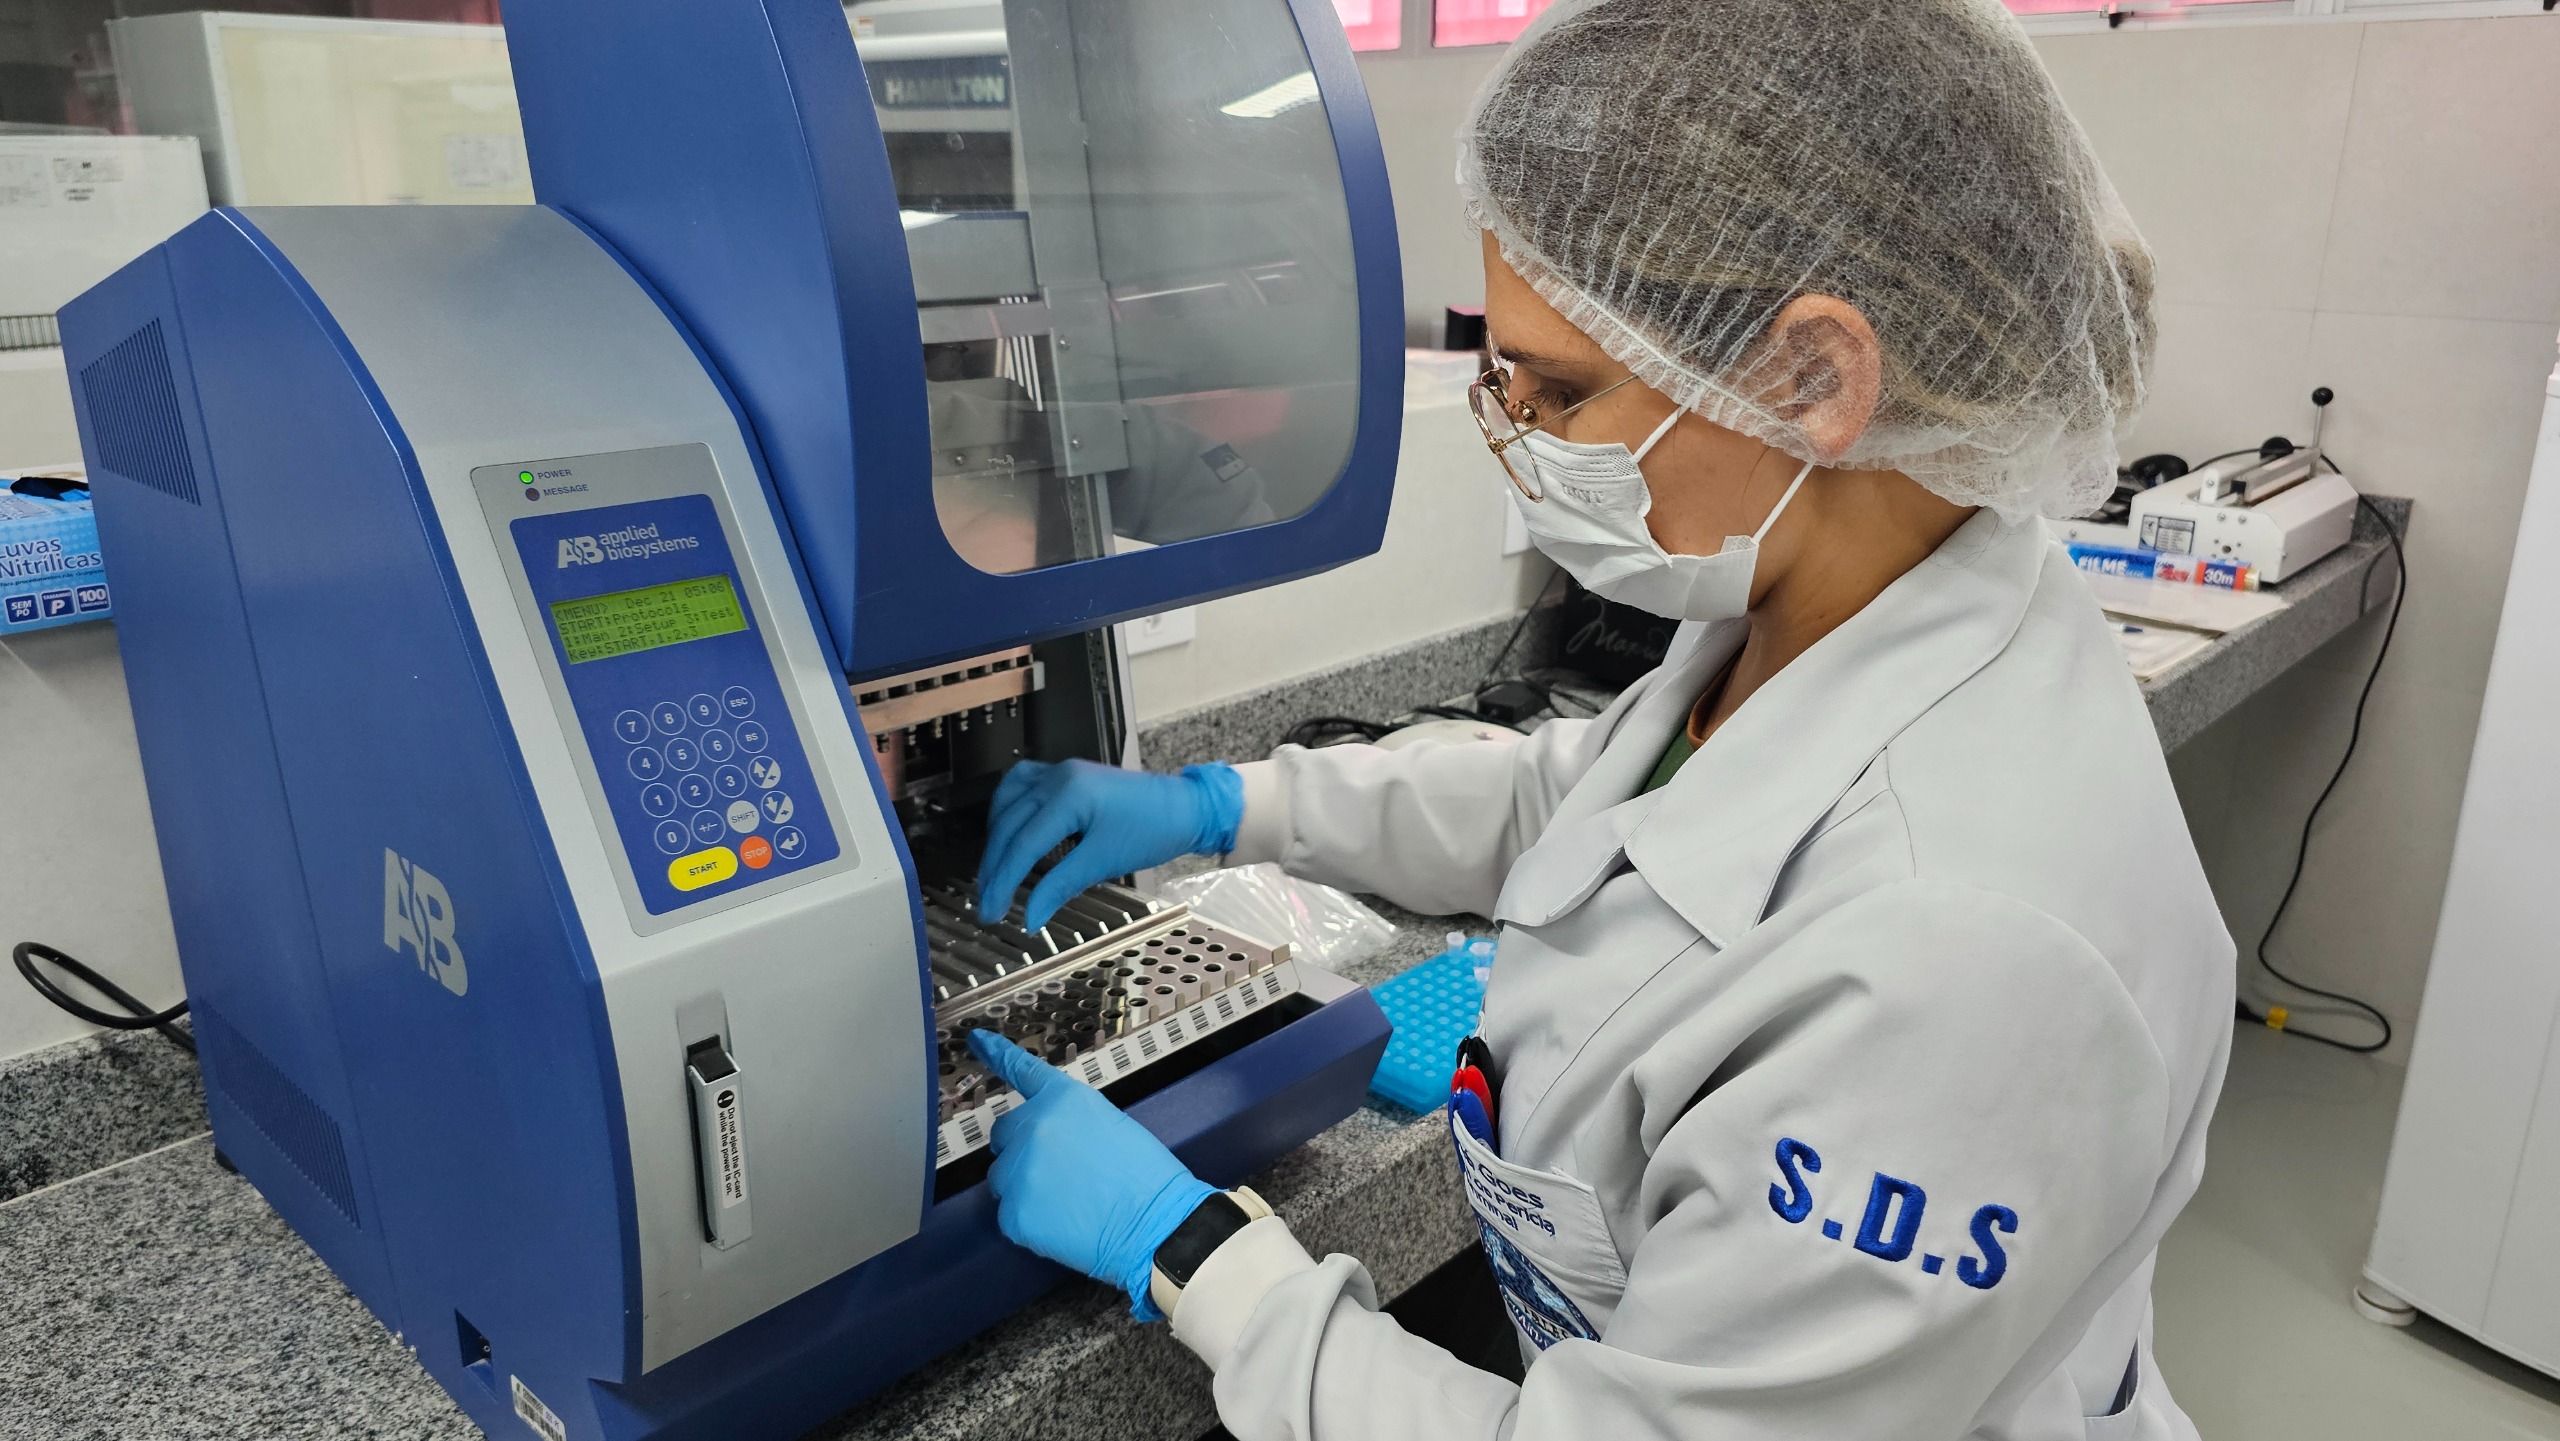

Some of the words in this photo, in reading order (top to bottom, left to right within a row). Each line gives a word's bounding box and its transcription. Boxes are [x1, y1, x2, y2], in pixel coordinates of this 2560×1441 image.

[538, 469, 572, 479] POWER
[543, 484, 589, 497] MESSAGE
[599, 523, 659, 549] applied
[605, 536, 699, 561] biosystems
[0, 552, 102, 579] Nitrílicas
[2077, 556, 2130, 575] FILME
[2203, 567, 2234, 586] 30m
[11, 599, 32, 610] SEM
[78, 588, 107, 603] 100
[625, 596, 651, 609] Dec
[659, 590, 675, 603] 21
[684, 581, 726, 599] 05:06
[51, 599, 66, 615] P
[627, 721, 636, 733] 7
[664, 713, 675, 725] 8
[700, 704, 710, 716] 9
[730, 697, 748, 708] ESC
[642, 757, 651, 769] 4
[677, 748, 687, 760] 5
[713, 740, 723, 752] 6
[745, 732, 758, 742] BS
[654, 794, 664, 806] 1
[690, 785, 700, 797] 2
[726, 775, 736, 787] 3
[667, 831, 677, 844] 0
[731, 810, 756, 824] SHIFT
[689, 861, 718, 877] START
[745, 846, 768, 859] STOP
[718, 1110, 729, 1132] while
[727, 1107, 736, 1120] Do
[728, 1120, 738, 1134] not
[721, 1133, 729, 1147] the
[729, 1134, 739, 1155] eject
[721, 1147, 731, 1172] power
[732, 1154, 740, 1169] the
[725, 1172, 732, 1181] is
[1478, 1163, 1545, 1209] Goes
[1769, 1137, 2018, 1289] S.D.S
